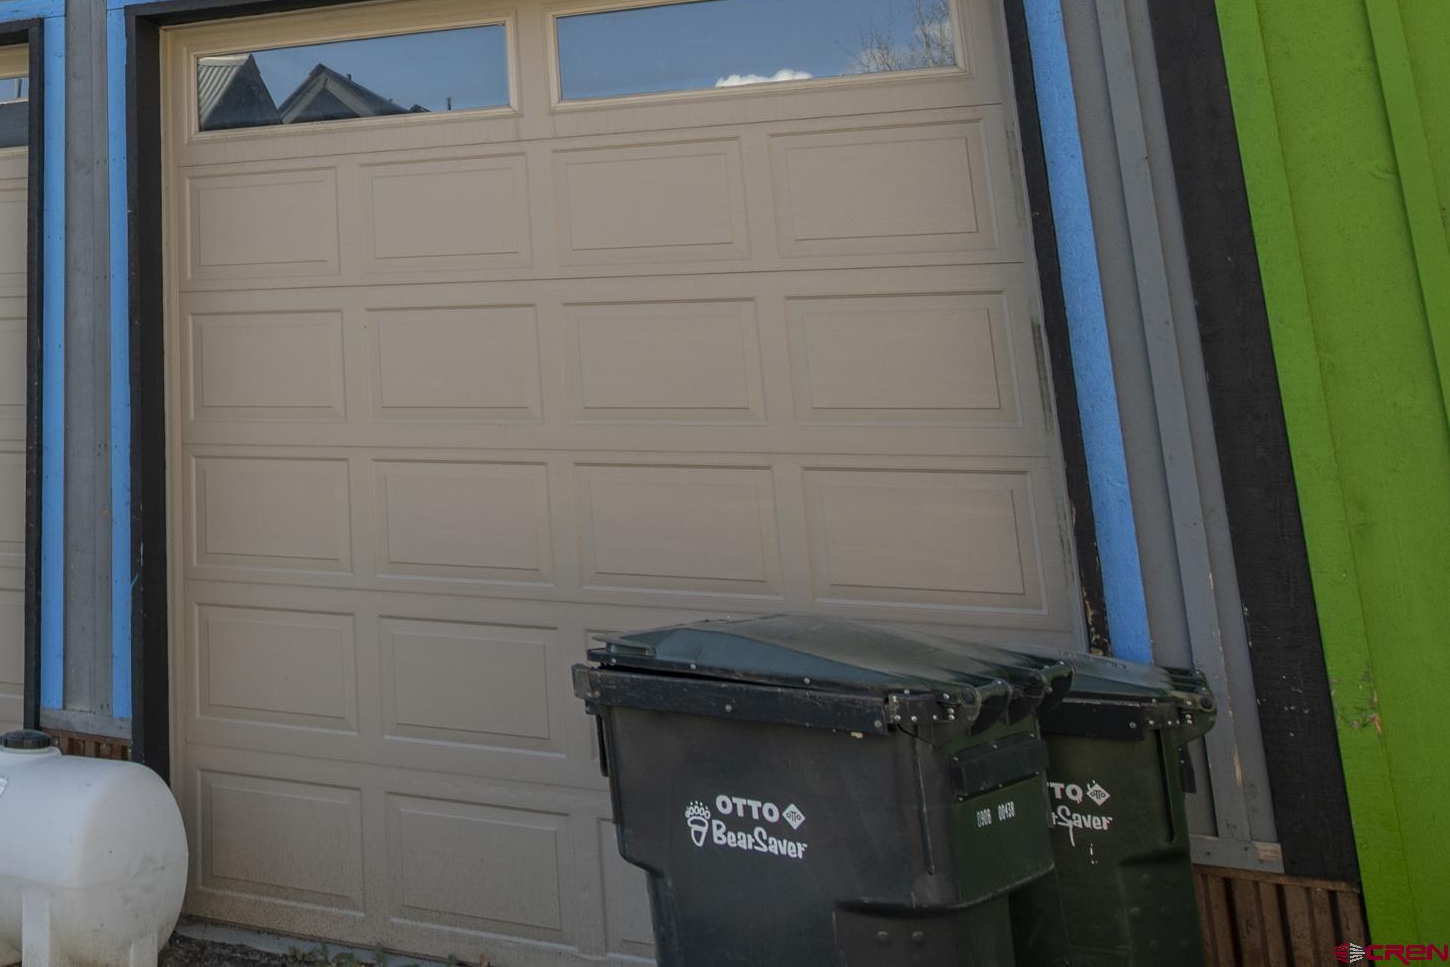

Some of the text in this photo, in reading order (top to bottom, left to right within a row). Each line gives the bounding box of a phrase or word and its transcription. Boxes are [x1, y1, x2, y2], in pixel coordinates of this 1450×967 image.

[1047, 782, 1083, 801] TO
[715, 794, 780, 823] OTTO
[785, 810, 802, 821] OTTO
[712, 819, 808, 859] BearSaver
